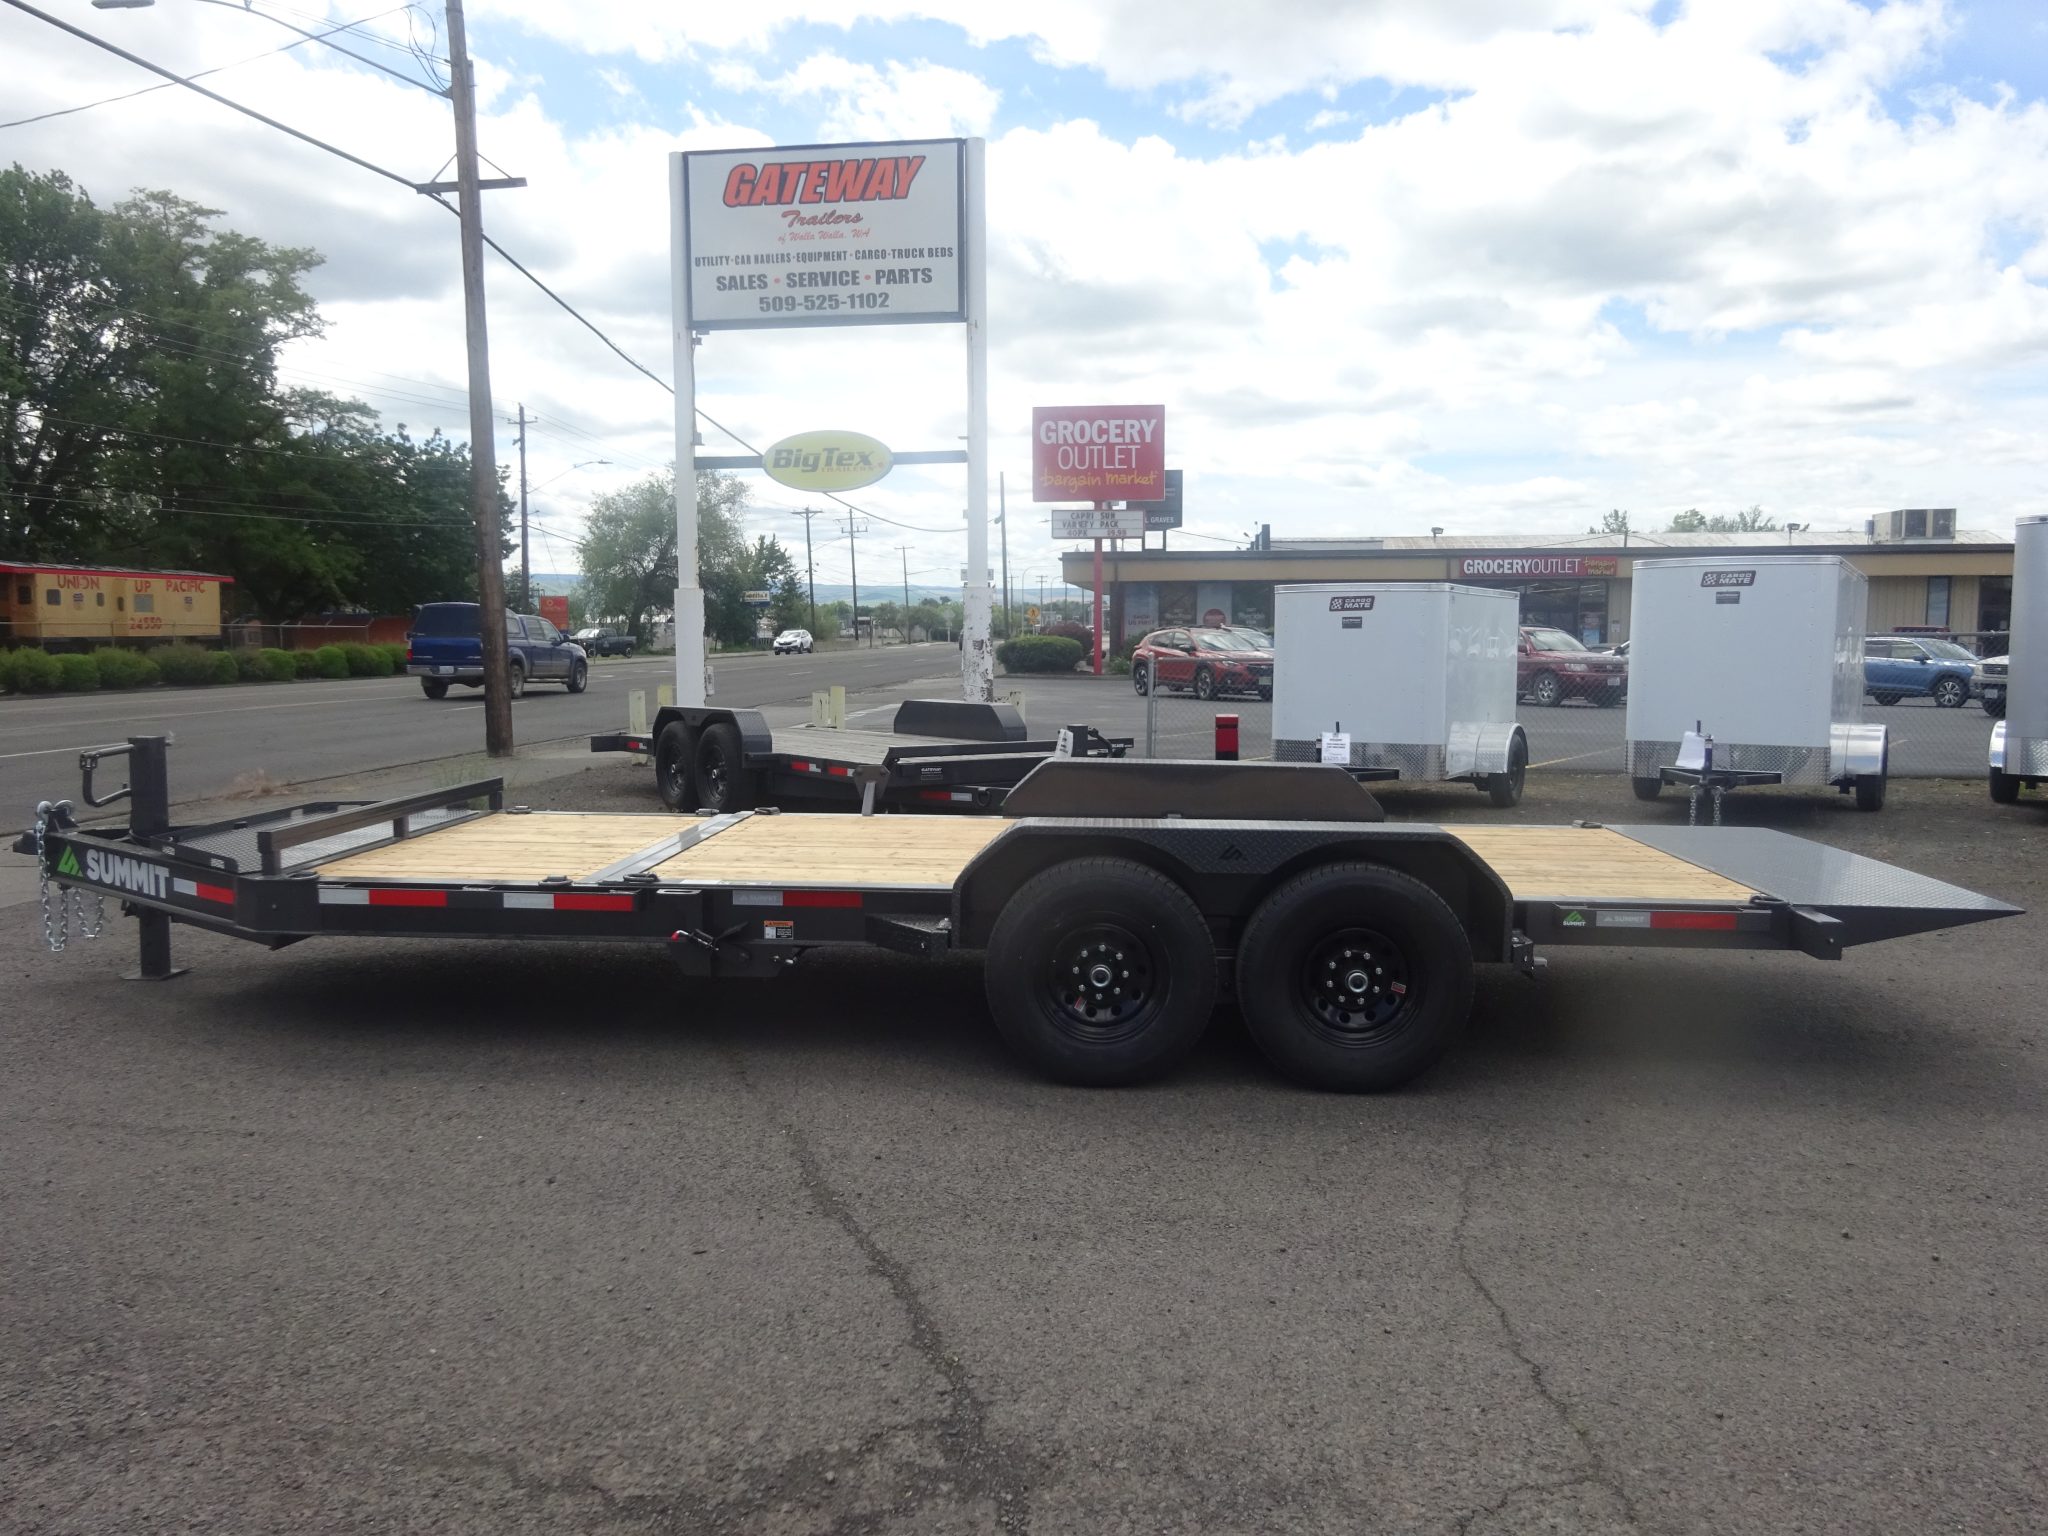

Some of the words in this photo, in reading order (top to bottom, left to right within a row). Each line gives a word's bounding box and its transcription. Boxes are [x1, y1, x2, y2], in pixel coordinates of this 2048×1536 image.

[722, 155, 926, 208] GATEWAY
[781, 209, 864, 228] Trailers
[694, 255, 731, 268] UTILITY
[734, 254, 752, 266] CAR
[753, 252, 792, 265] HAULERS
[796, 250, 848, 264] EQUIPMENT
[854, 249, 887, 261] CARGO
[891, 247, 925, 259] TRUCK
[927, 247, 954, 258] BEDS
[715, 273, 769, 292] SALES
[785, 270, 861, 289] SERVICE
[875, 267, 933, 285] PARTS
[758, 292, 890, 312] 509-525-1102
[1039, 419, 1158, 445] GROCERY
[1057, 445, 1141, 470] OUTLET
[1039, 466, 1101, 494] bargain
[1105, 470, 1157, 486] market
[1463, 559, 1532, 575] GROCERY
[1531, 558, 1582, 573] OUTLET
[57, 574, 100, 590] UNION
[134, 579, 152, 592] UP
[165, 579, 206, 593] PACIFIC
[86, 849, 170, 900] SUMMIT
